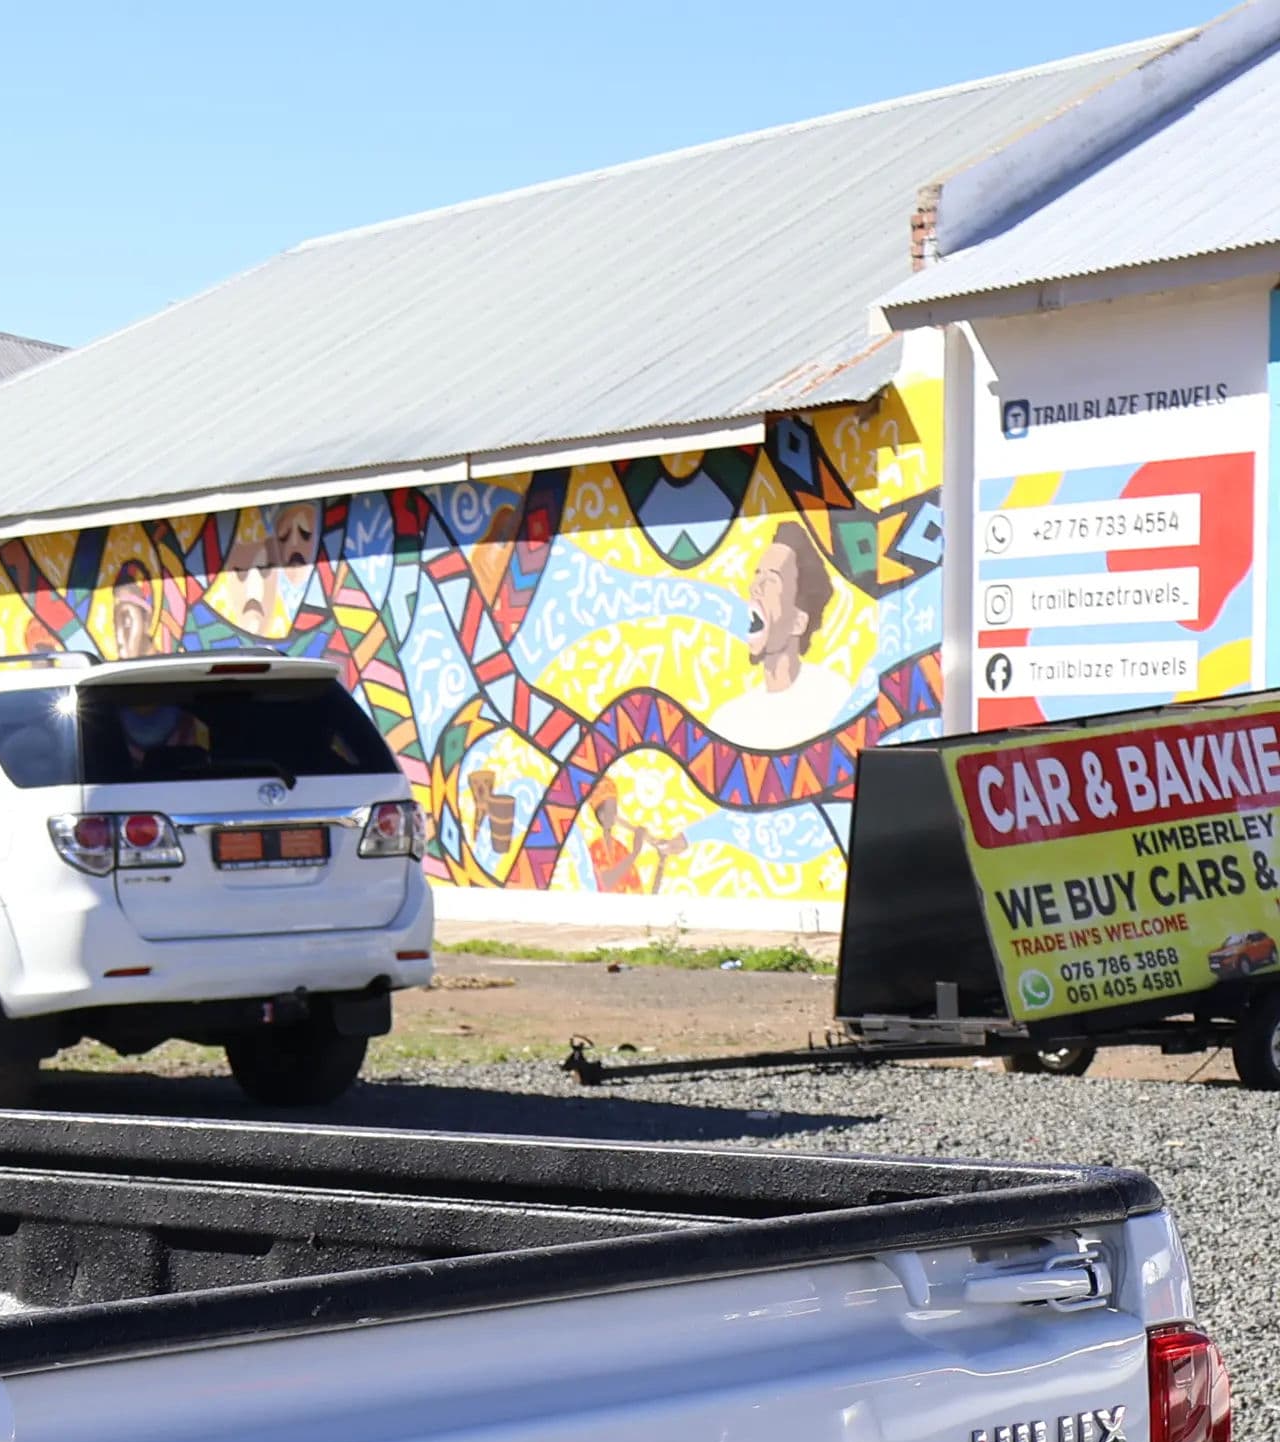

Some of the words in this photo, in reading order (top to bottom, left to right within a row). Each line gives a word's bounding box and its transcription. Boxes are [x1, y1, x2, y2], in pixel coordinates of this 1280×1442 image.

[1033, 394, 1139, 426] TRAILBLAZE
[1144, 383, 1228, 412] TRAVELS
[1069, 519, 1089, 538] 76
[1095, 515, 1127, 536] 733
[1134, 511, 1179, 533] 4554
[1030, 659, 1113, 681] Trailblaze
[1120, 657, 1187, 677] Travels
[977, 757, 1080, 834] CAR
[1080, 750, 1118, 820] &
[1116, 725, 1280, 813] BAKKIE
[1132, 813, 1274, 857] KIMBERLEY
[995, 883, 1062, 930] WE
[1063, 871, 1138, 921] BUY
[1148, 855, 1246, 907] CARS
[1252, 850, 1278, 891] &
[1011, 932, 1067, 958] TRADE
[1070, 927, 1103, 948] IN'S
[1104, 913, 1189, 943] WELCOME
[1060, 960, 1095, 982] 076
[1097, 954, 1131, 976] 786
[1134, 947, 1179, 970] 3868
[1066, 984, 1099, 1004] 061
[1103, 977, 1137, 997] 405
[1142, 969, 1183, 992] 4581
